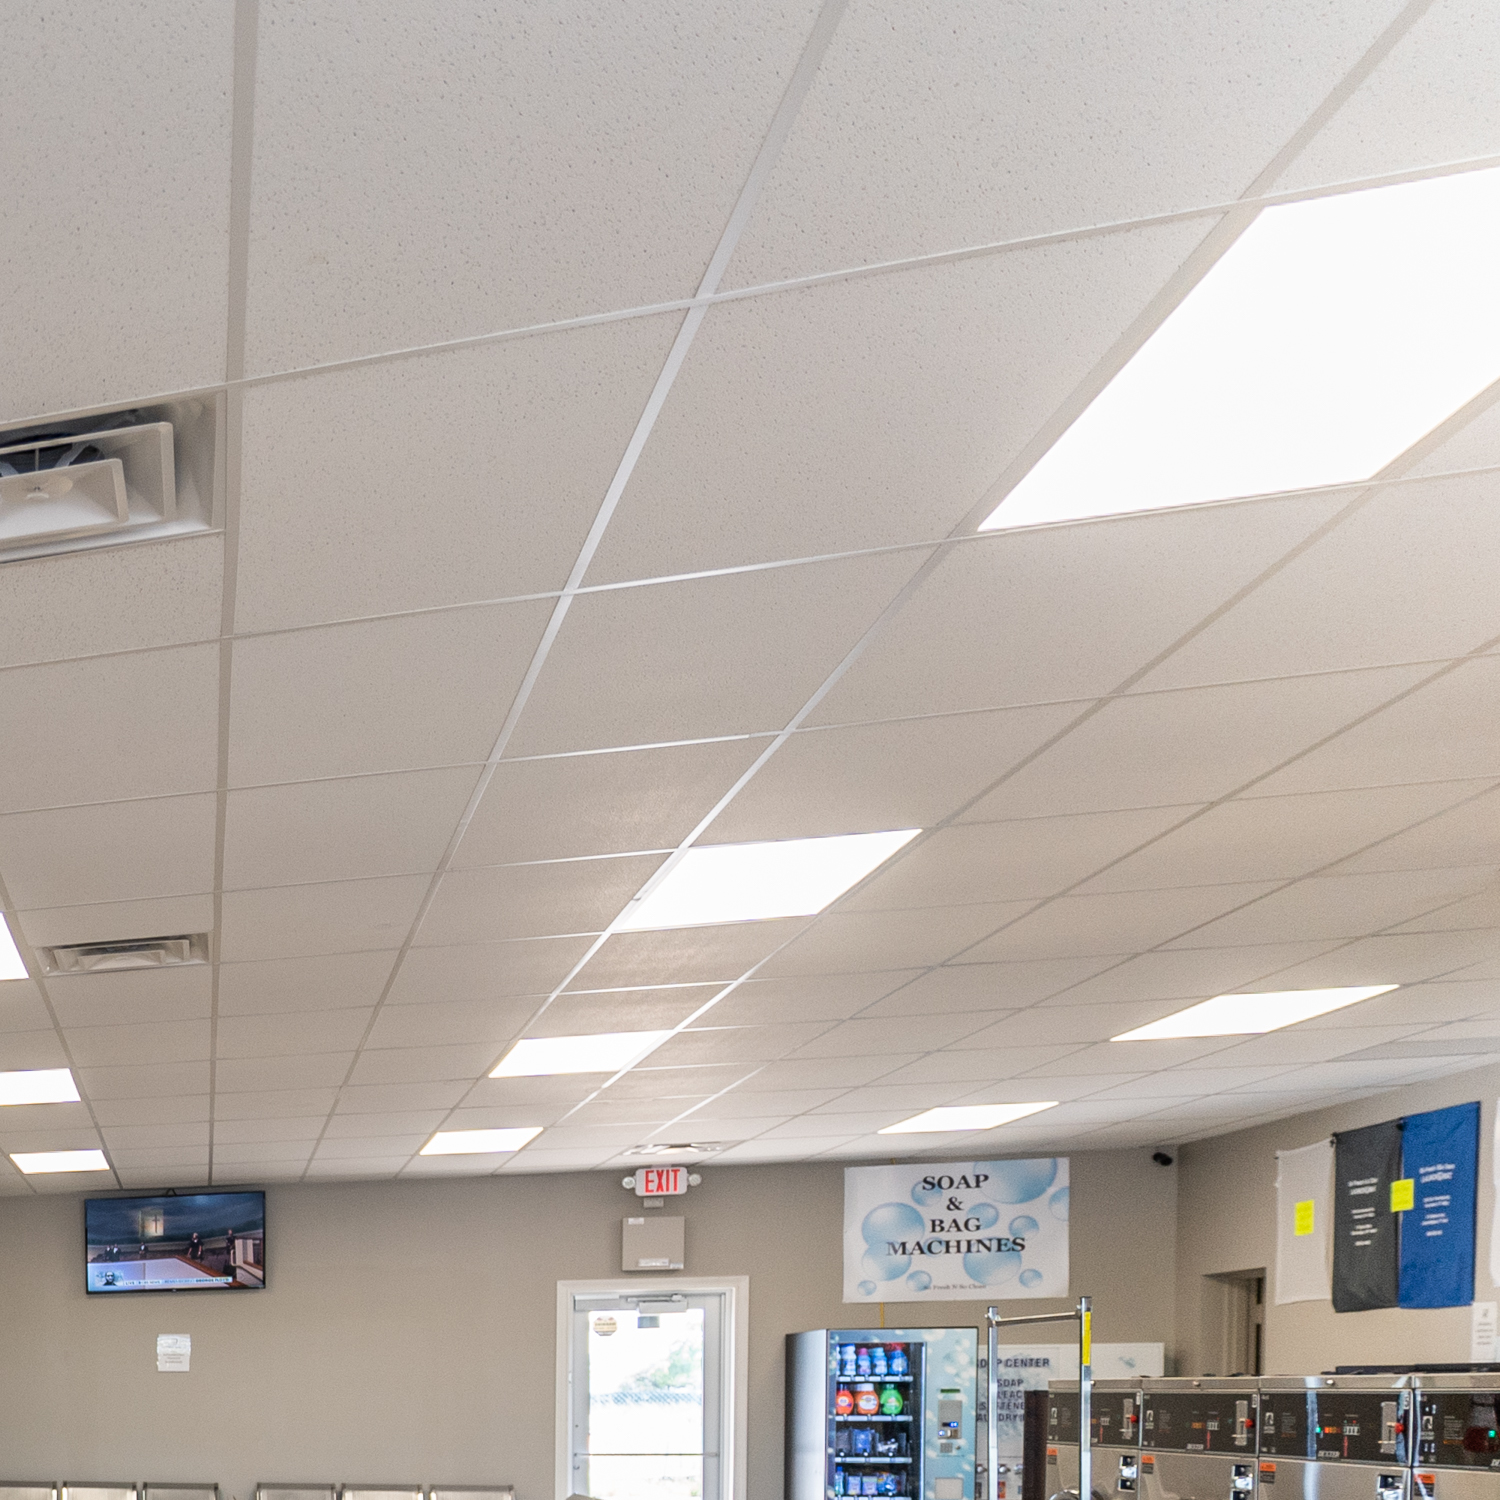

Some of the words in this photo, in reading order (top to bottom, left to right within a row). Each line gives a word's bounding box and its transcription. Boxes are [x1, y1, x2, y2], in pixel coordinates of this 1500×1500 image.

[644, 1168, 681, 1193] EXIT
[922, 1173, 989, 1191] SOAP
[946, 1196, 964, 1212] &
[929, 1217, 982, 1233] BAG
[886, 1237, 1026, 1256] MACHINES
[1005, 1358, 1050, 1368] CENTER
[997, 1378, 1024, 1387] SOAP
